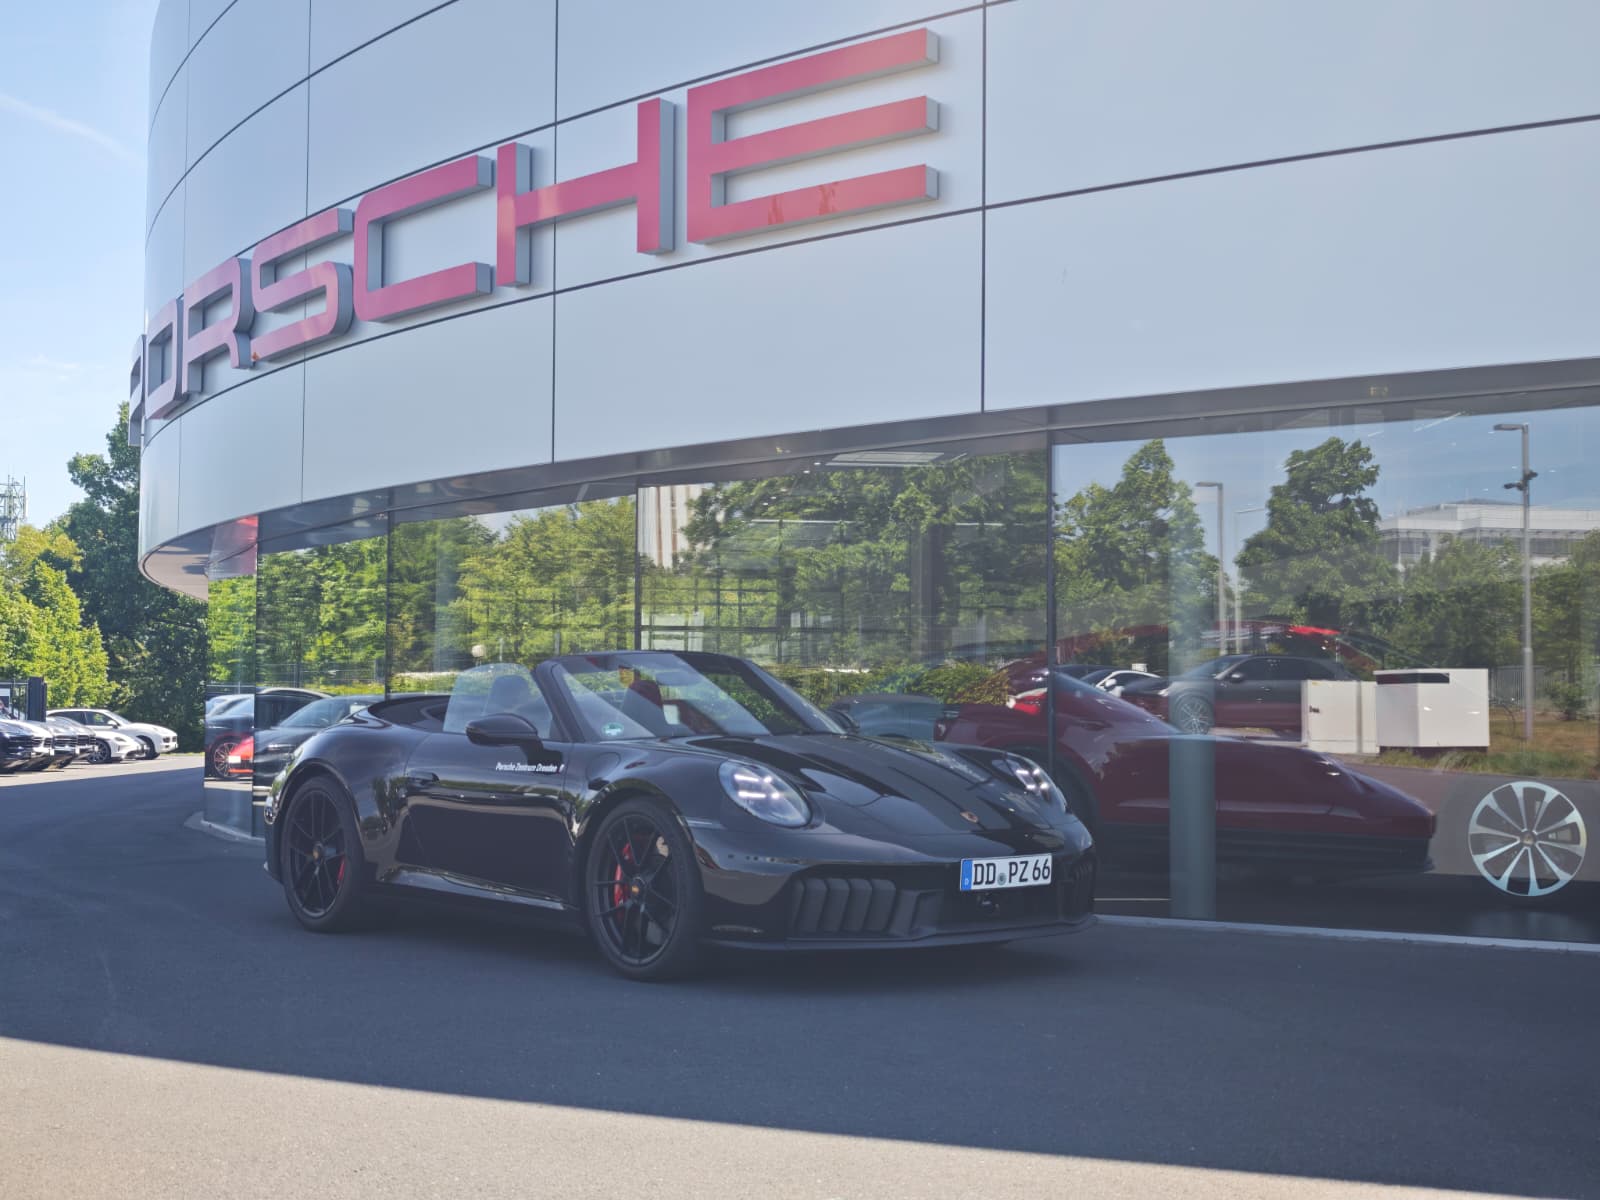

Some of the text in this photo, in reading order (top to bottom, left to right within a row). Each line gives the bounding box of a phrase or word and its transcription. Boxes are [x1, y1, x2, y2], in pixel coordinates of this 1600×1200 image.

[128, 27, 940, 447] PORSCHE
[973, 859, 1051, 885] DD PZ 66
